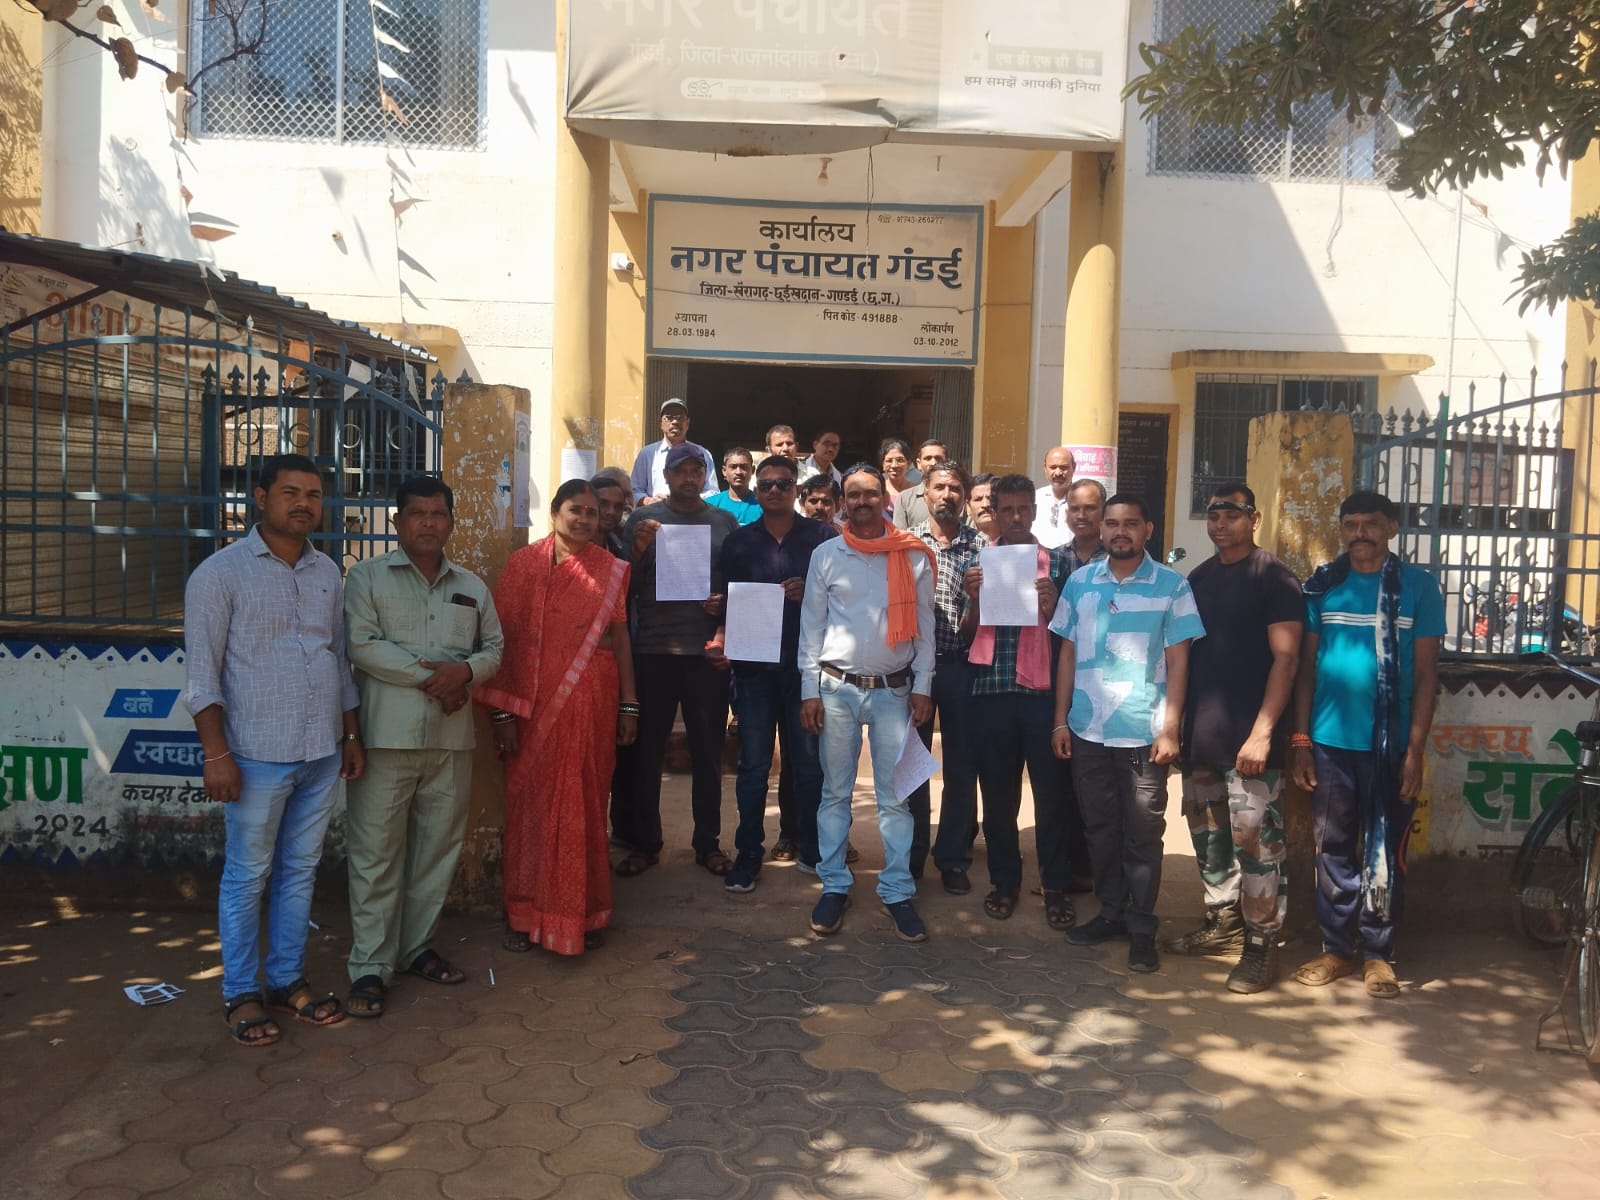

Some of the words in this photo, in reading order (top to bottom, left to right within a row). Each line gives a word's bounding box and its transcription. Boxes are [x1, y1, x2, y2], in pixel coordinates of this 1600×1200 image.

[964, 75, 982, 86] हम
[1022, 77, 1062, 90] आपकी
[1066, 79, 1101, 93] दुनिया
[759, 215, 856, 243] कार्यालय
[670, 246, 747, 276] नगर
[754, 243, 880, 281] पंचायत
[887, 247, 963, 290] गंडई
[861, 312, 898, 324] 491888
